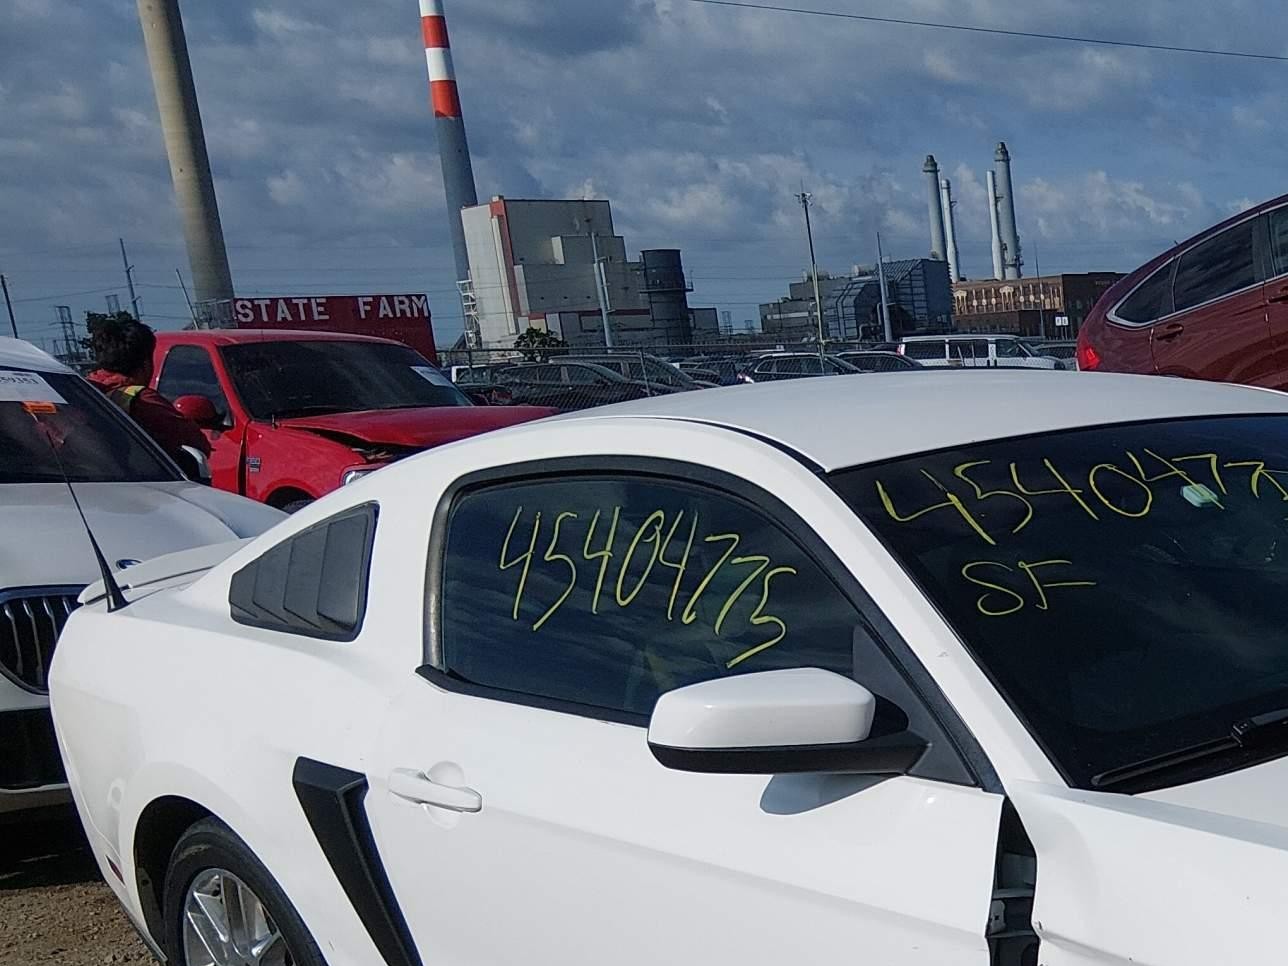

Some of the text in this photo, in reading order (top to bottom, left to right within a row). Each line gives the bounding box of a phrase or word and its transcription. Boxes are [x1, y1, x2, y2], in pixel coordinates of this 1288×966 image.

[234, 296, 429, 322] STATE FARM
[500, 505, 796, 668] 45404775
[962, 560, 1095, 616] SF
